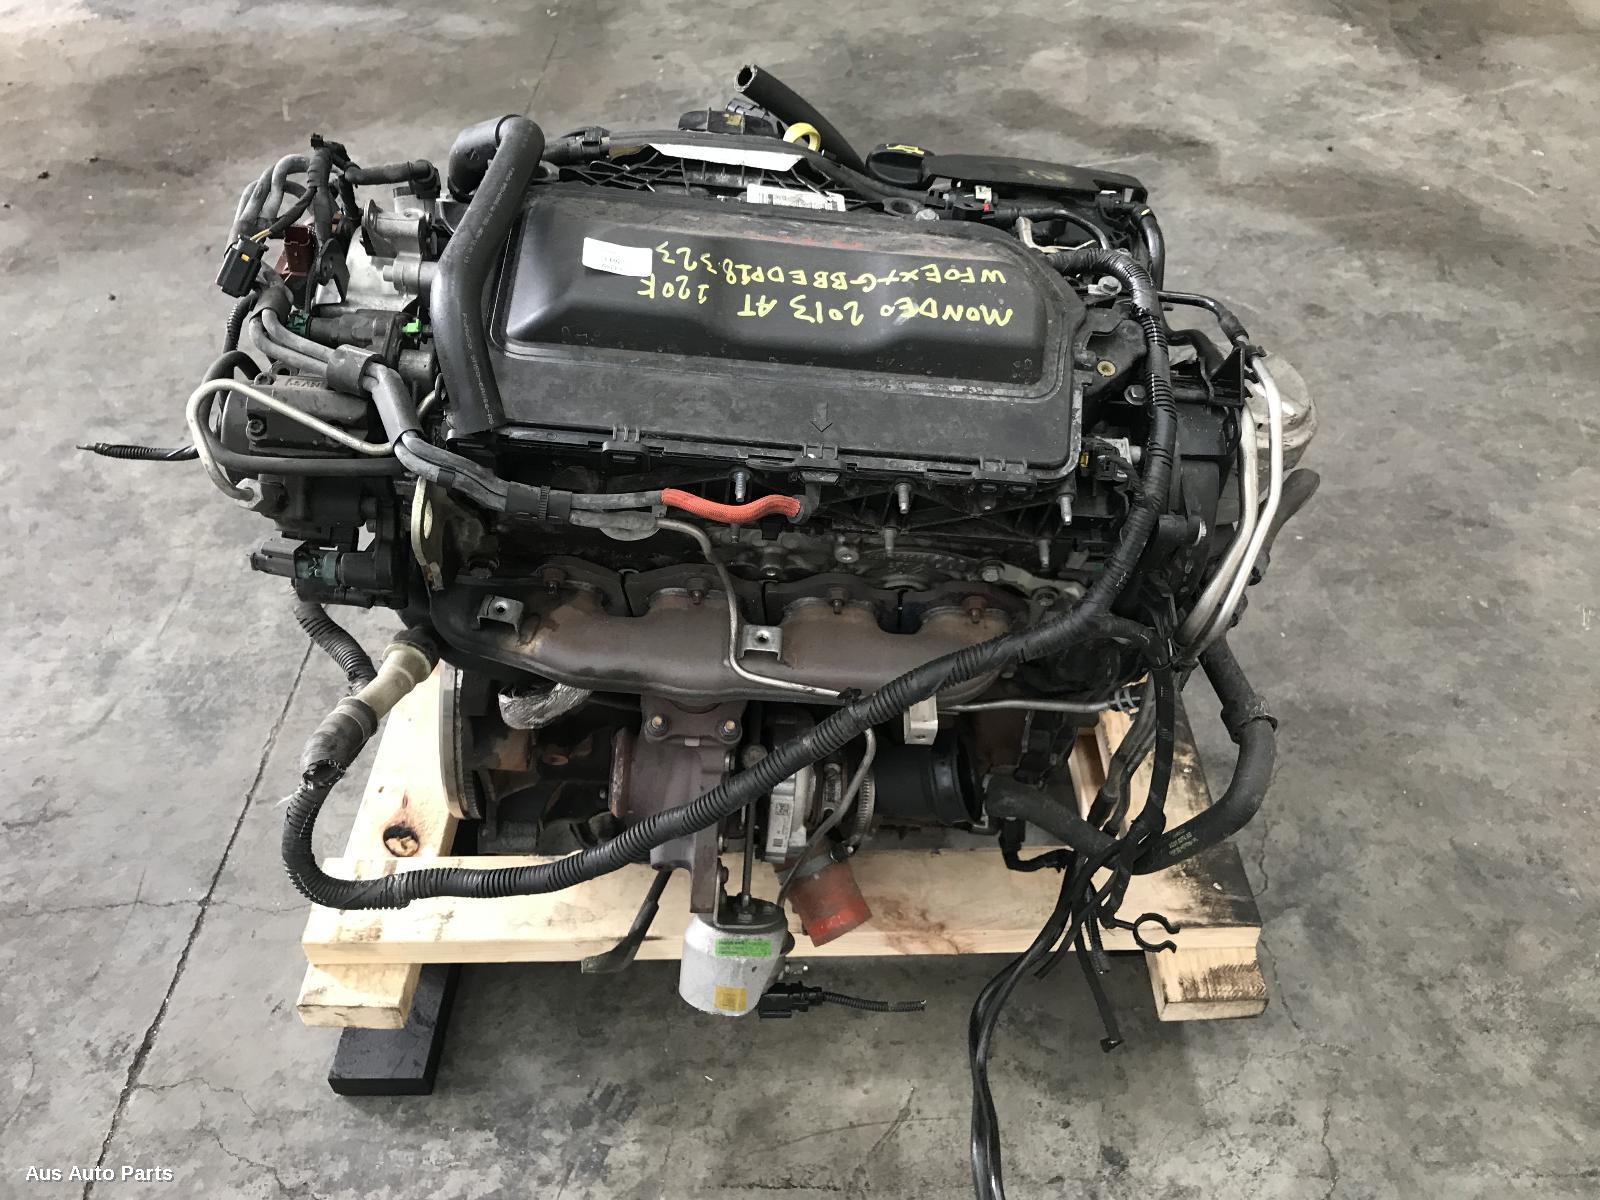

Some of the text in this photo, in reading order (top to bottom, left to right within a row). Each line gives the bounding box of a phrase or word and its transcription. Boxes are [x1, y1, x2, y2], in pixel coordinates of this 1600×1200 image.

[637, 273, 710, 304] 120K
[737, 294, 1013, 326] MONDEO 2013 AT
